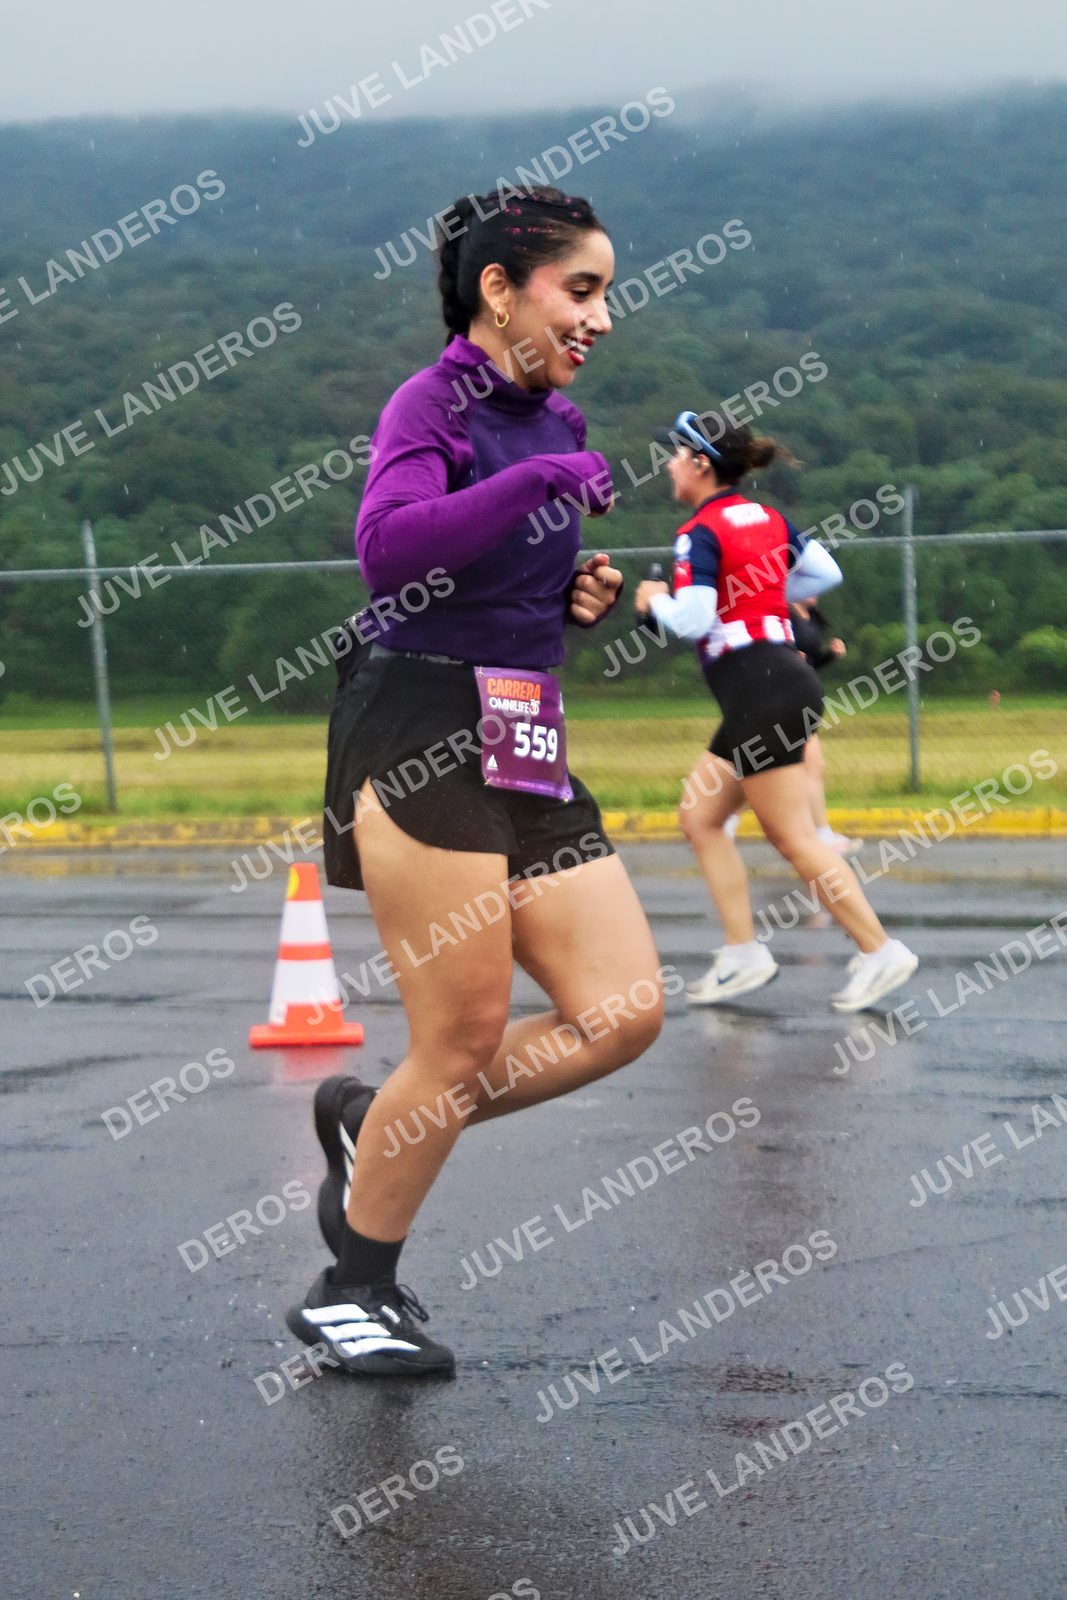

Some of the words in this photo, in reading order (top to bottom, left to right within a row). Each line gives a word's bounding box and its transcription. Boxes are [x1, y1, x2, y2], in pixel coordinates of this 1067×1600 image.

[487, 677, 542, 700] CARRERA
[489, 697, 530, 714] OMNILIFE
[514, 721, 558, 763] 559
